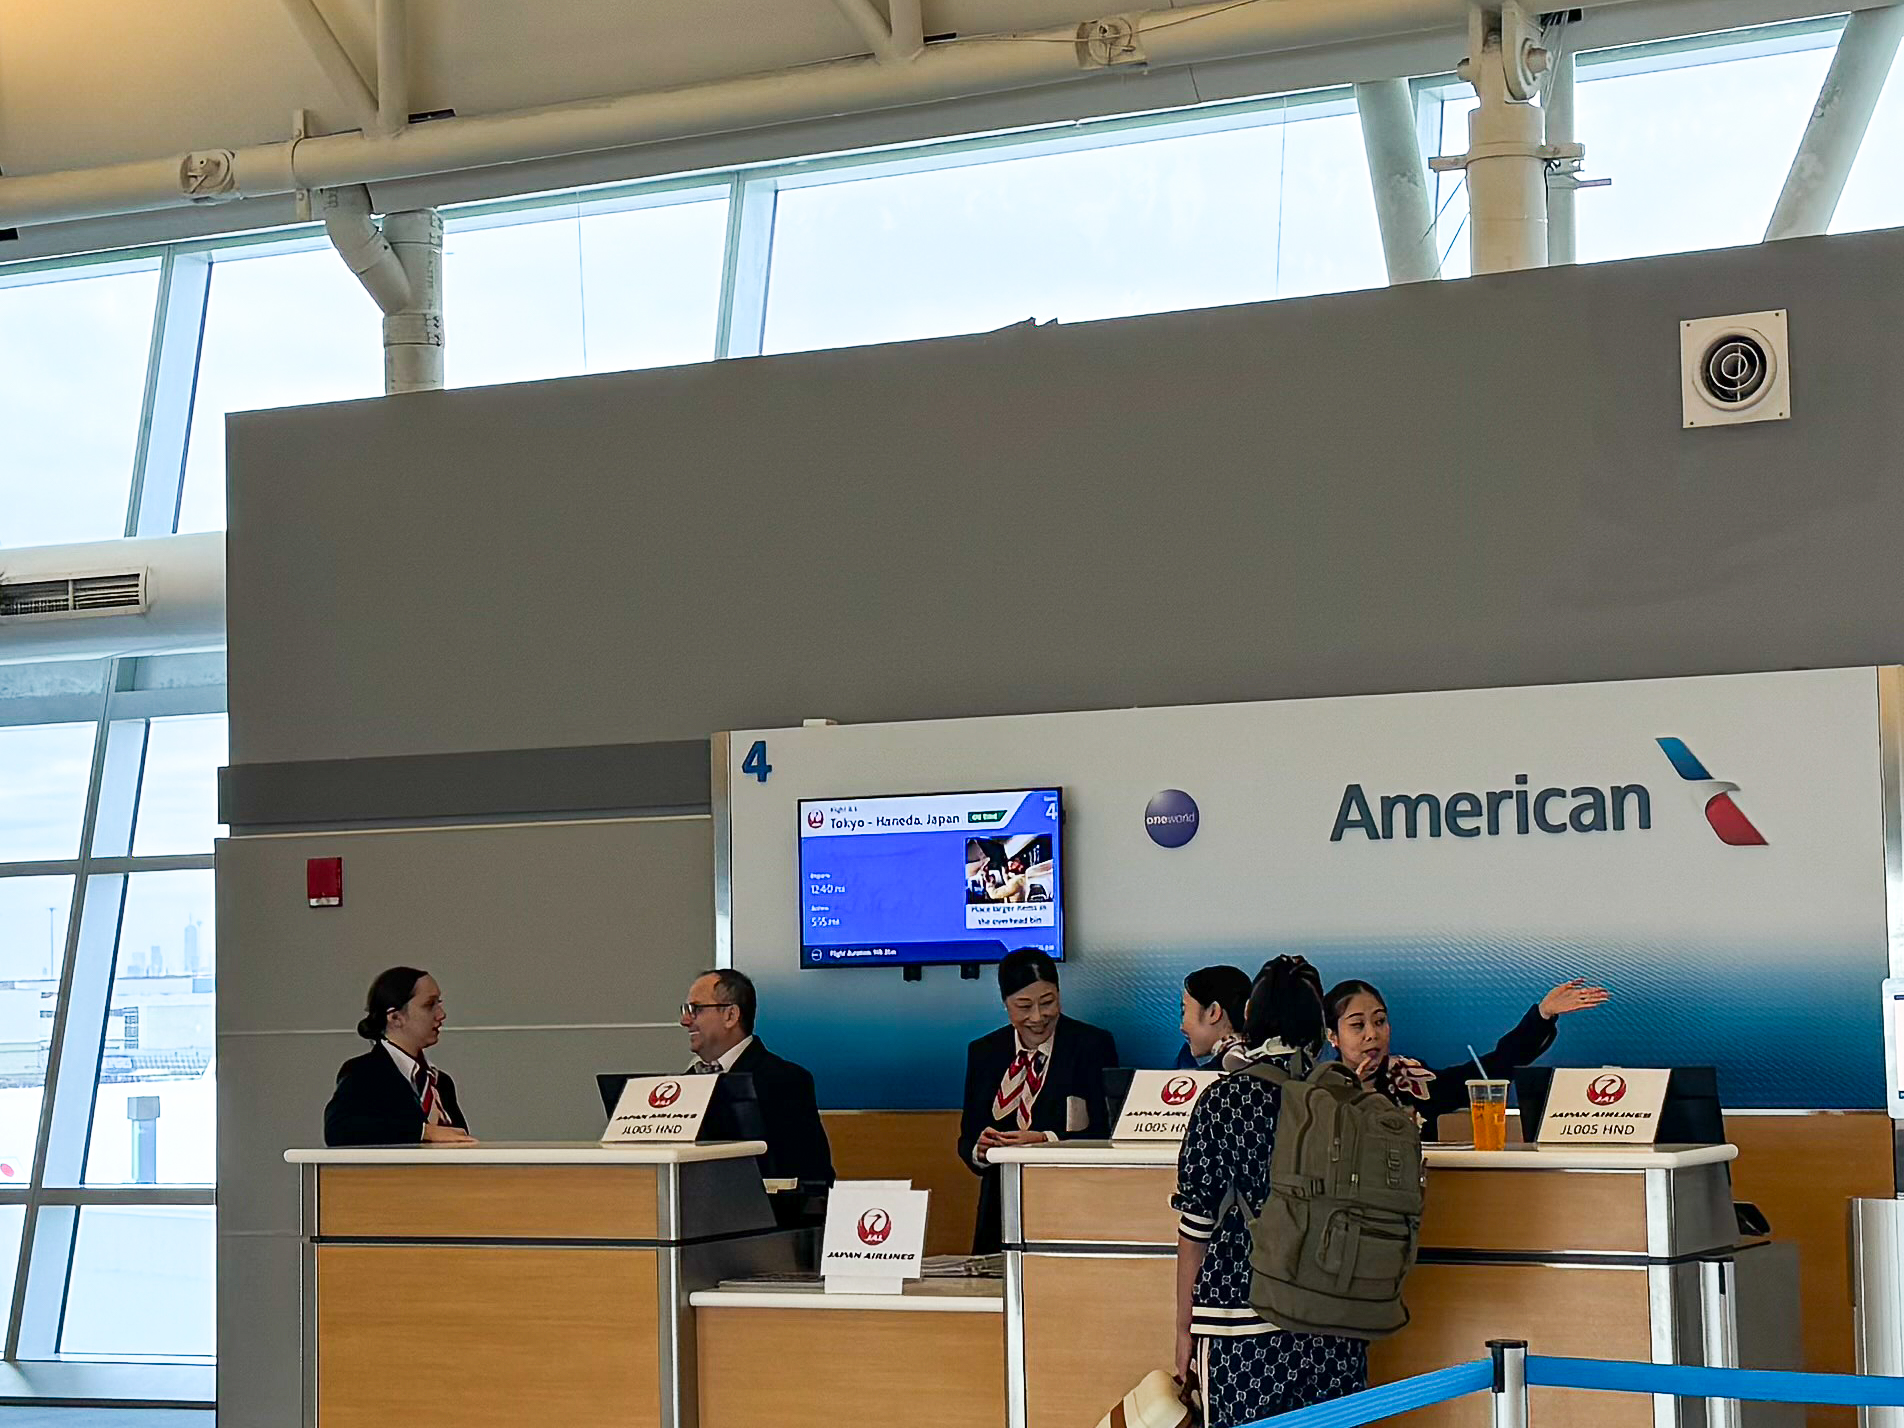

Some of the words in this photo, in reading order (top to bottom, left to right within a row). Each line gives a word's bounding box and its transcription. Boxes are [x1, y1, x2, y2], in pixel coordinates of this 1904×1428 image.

[742, 741, 772, 782] 4
[1045, 803, 1058, 820] 4
[1329, 773, 1652, 842] American
[831, 818, 865, 831] Tokyo
[927, 814, 960, 827] Japan
[1146, 812, 1195, 825] oneworld
[1170, 1122, 1188, 1133] HN
[1560, 1124, 1598, 1135] JL005
[1602, 1124, 1635, 1135] HND
[827, 1251, 863, 1259] JAPAN
[864, 1252, 915, 1260] AIRLINES
